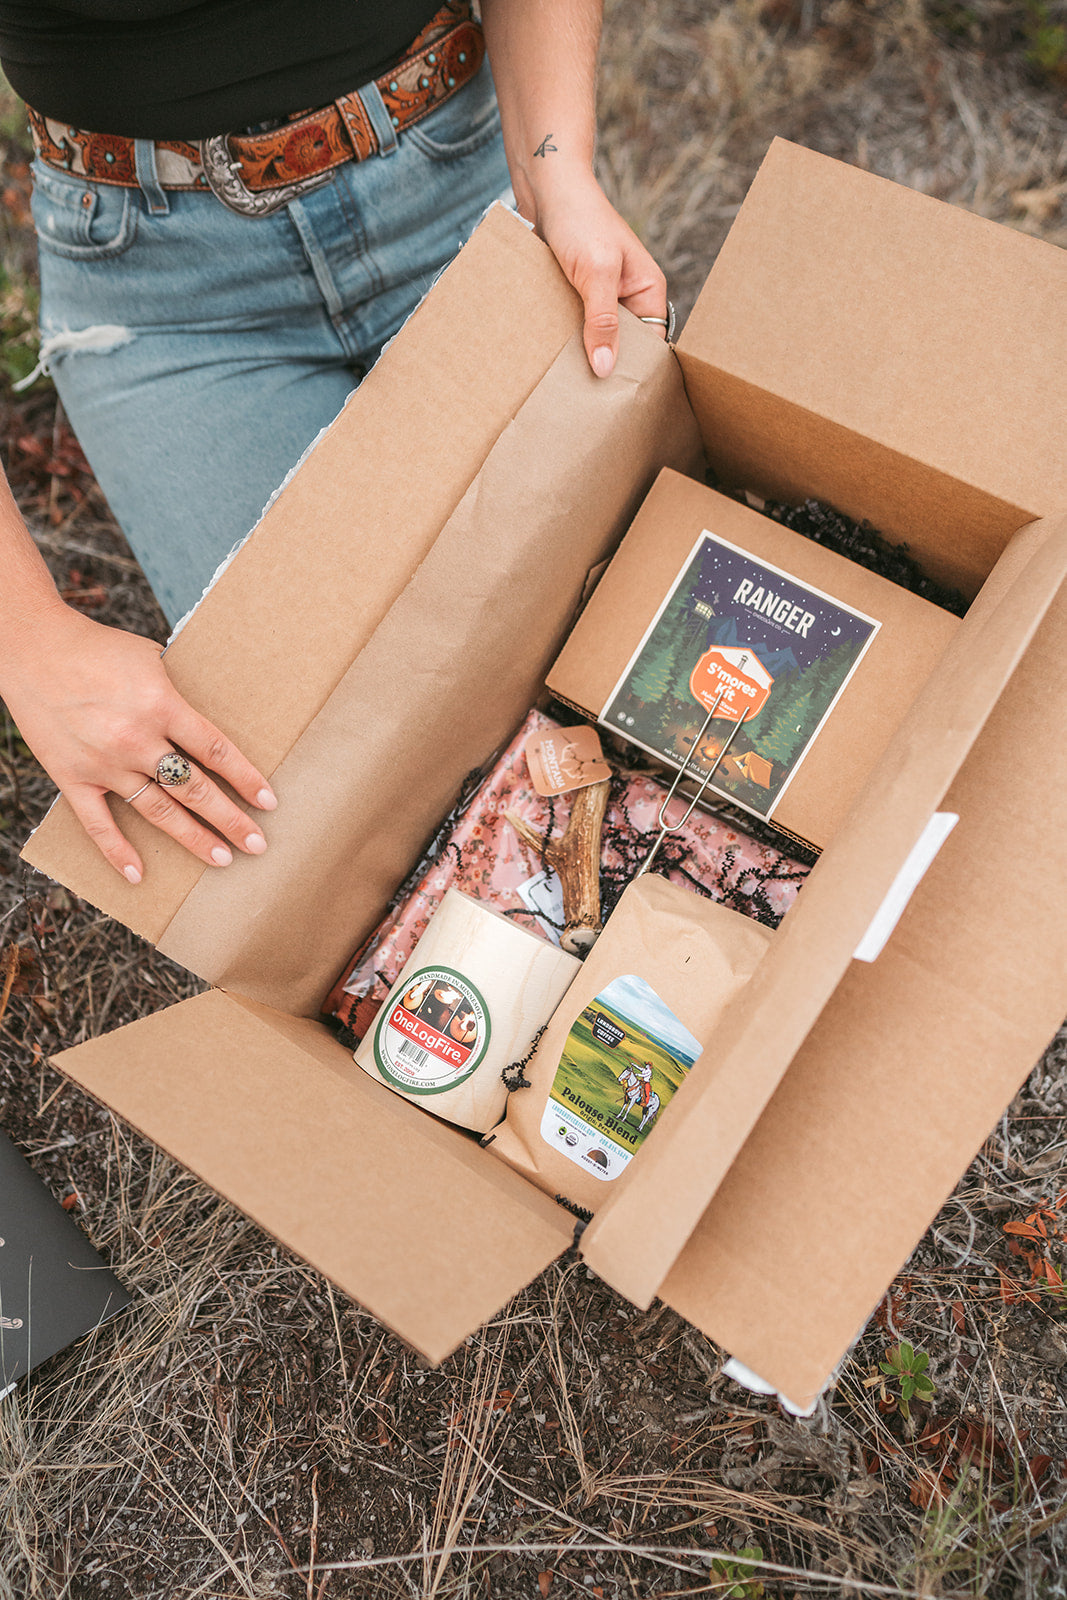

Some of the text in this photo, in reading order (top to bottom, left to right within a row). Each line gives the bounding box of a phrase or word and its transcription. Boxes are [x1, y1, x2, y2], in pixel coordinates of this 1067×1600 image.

[733, 578, 816, 639] RANGER
[707, 662, 758, 698] S'mores
[714, 682, 736, 702] Kit
[544, 739, 566, 789] MONTANA
[418, 972, 483, 1020] HANDMADE IN MINNESOTA
[393, 1010, 462, 1061] OneLogFire
[596, 1028, 616, 1043] COFFEE
[561, 1086, 604, 1122] Palouse
[604, 1116, 639, 1145] Blend
[580, 1110, 598, 1125] Origin:
[597, 1123, 611, 1135] Peru
